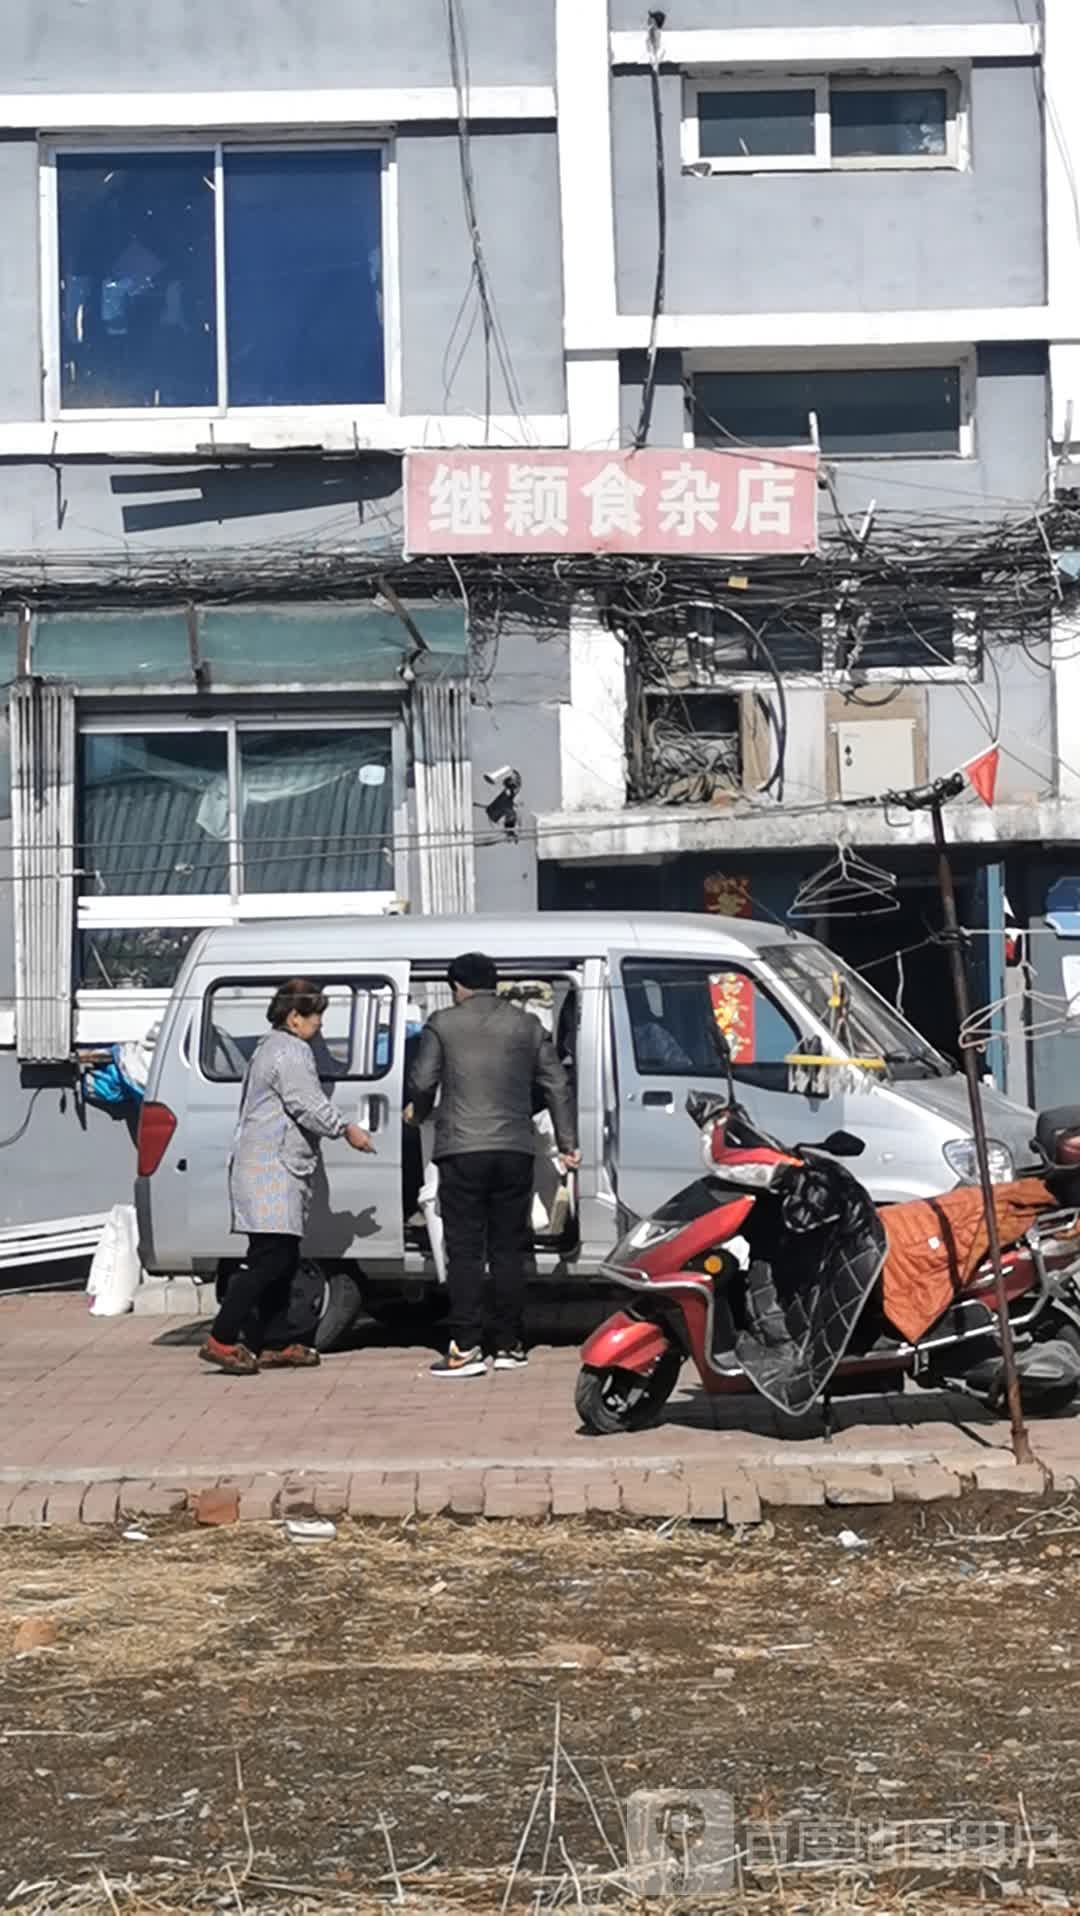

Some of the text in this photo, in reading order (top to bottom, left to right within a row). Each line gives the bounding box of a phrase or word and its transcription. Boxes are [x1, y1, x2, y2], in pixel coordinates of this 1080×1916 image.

[428, 462, 798, 537] 继颖食杂店
